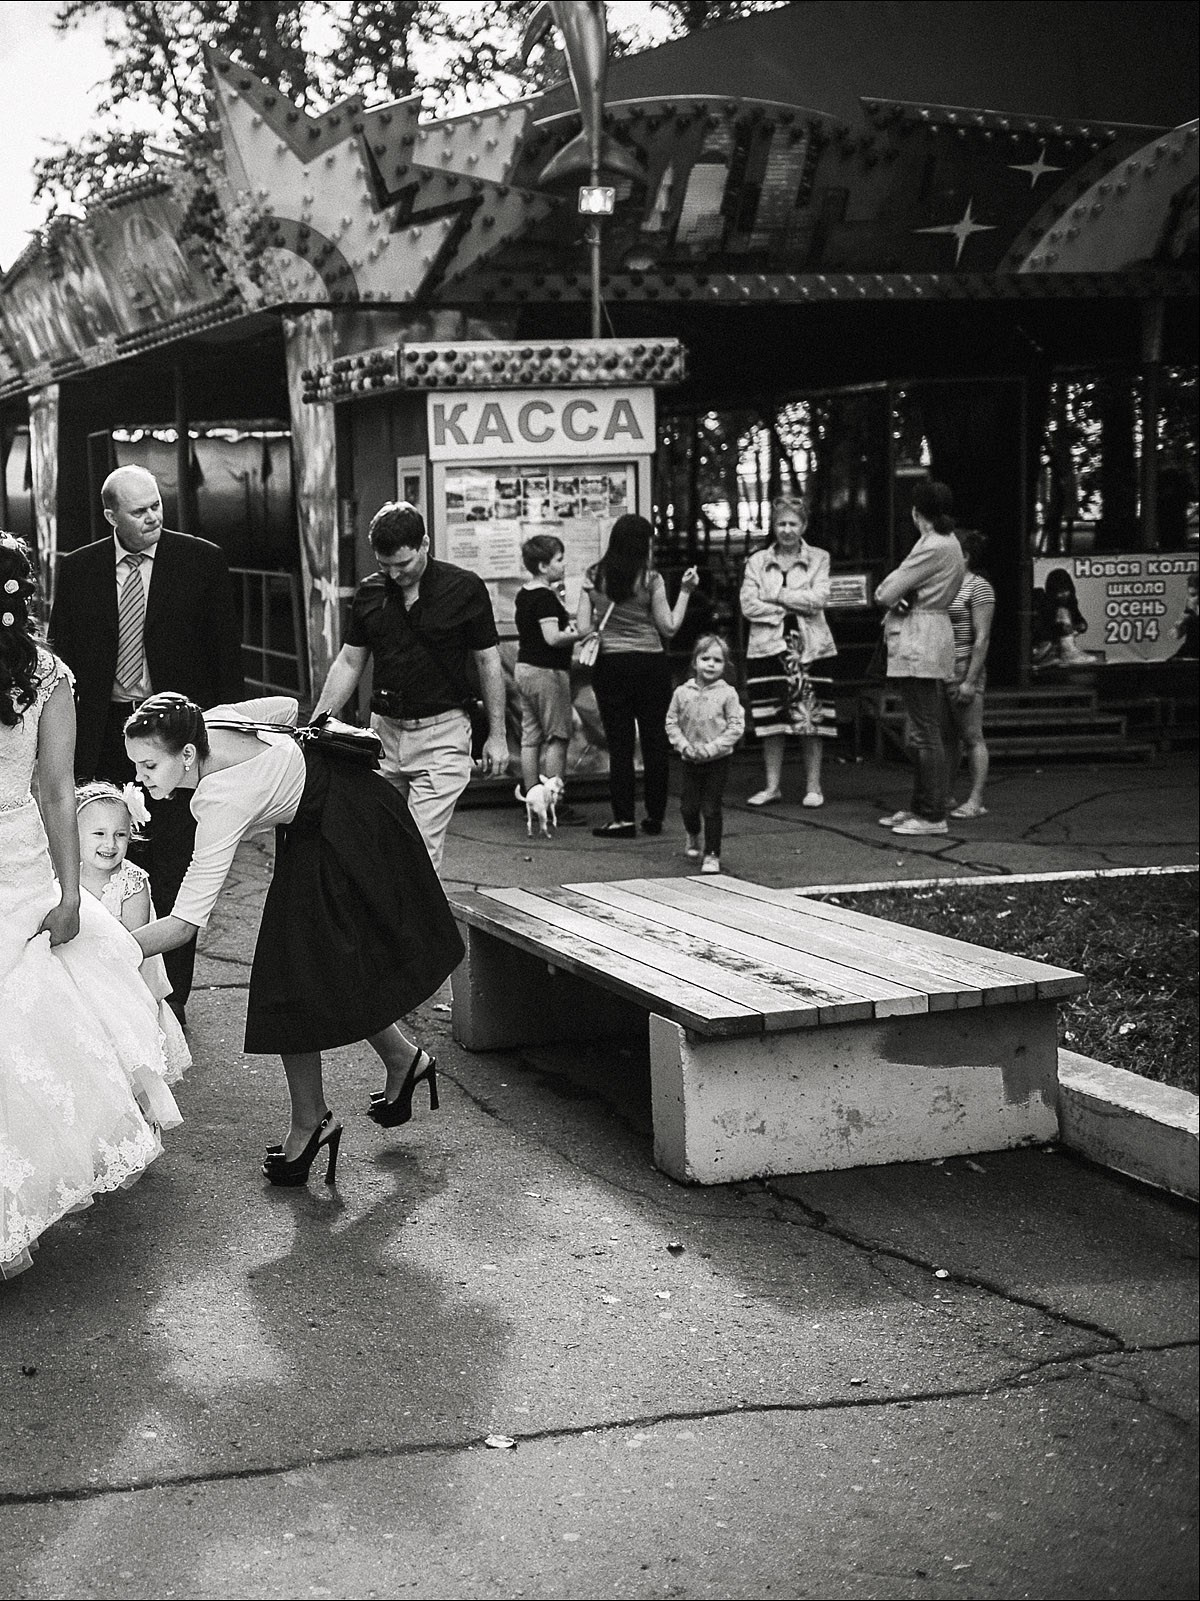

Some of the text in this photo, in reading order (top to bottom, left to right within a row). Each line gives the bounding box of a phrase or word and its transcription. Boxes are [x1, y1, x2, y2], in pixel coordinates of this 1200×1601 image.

[433, 399, 644, 446] КАССА
[1074, 558, 1141, 578] Новая
[1107, 580, 1166, 597] школа
[1105, 600, 1167, 617] осень
[1105, 619, 1159, 643] 2014
